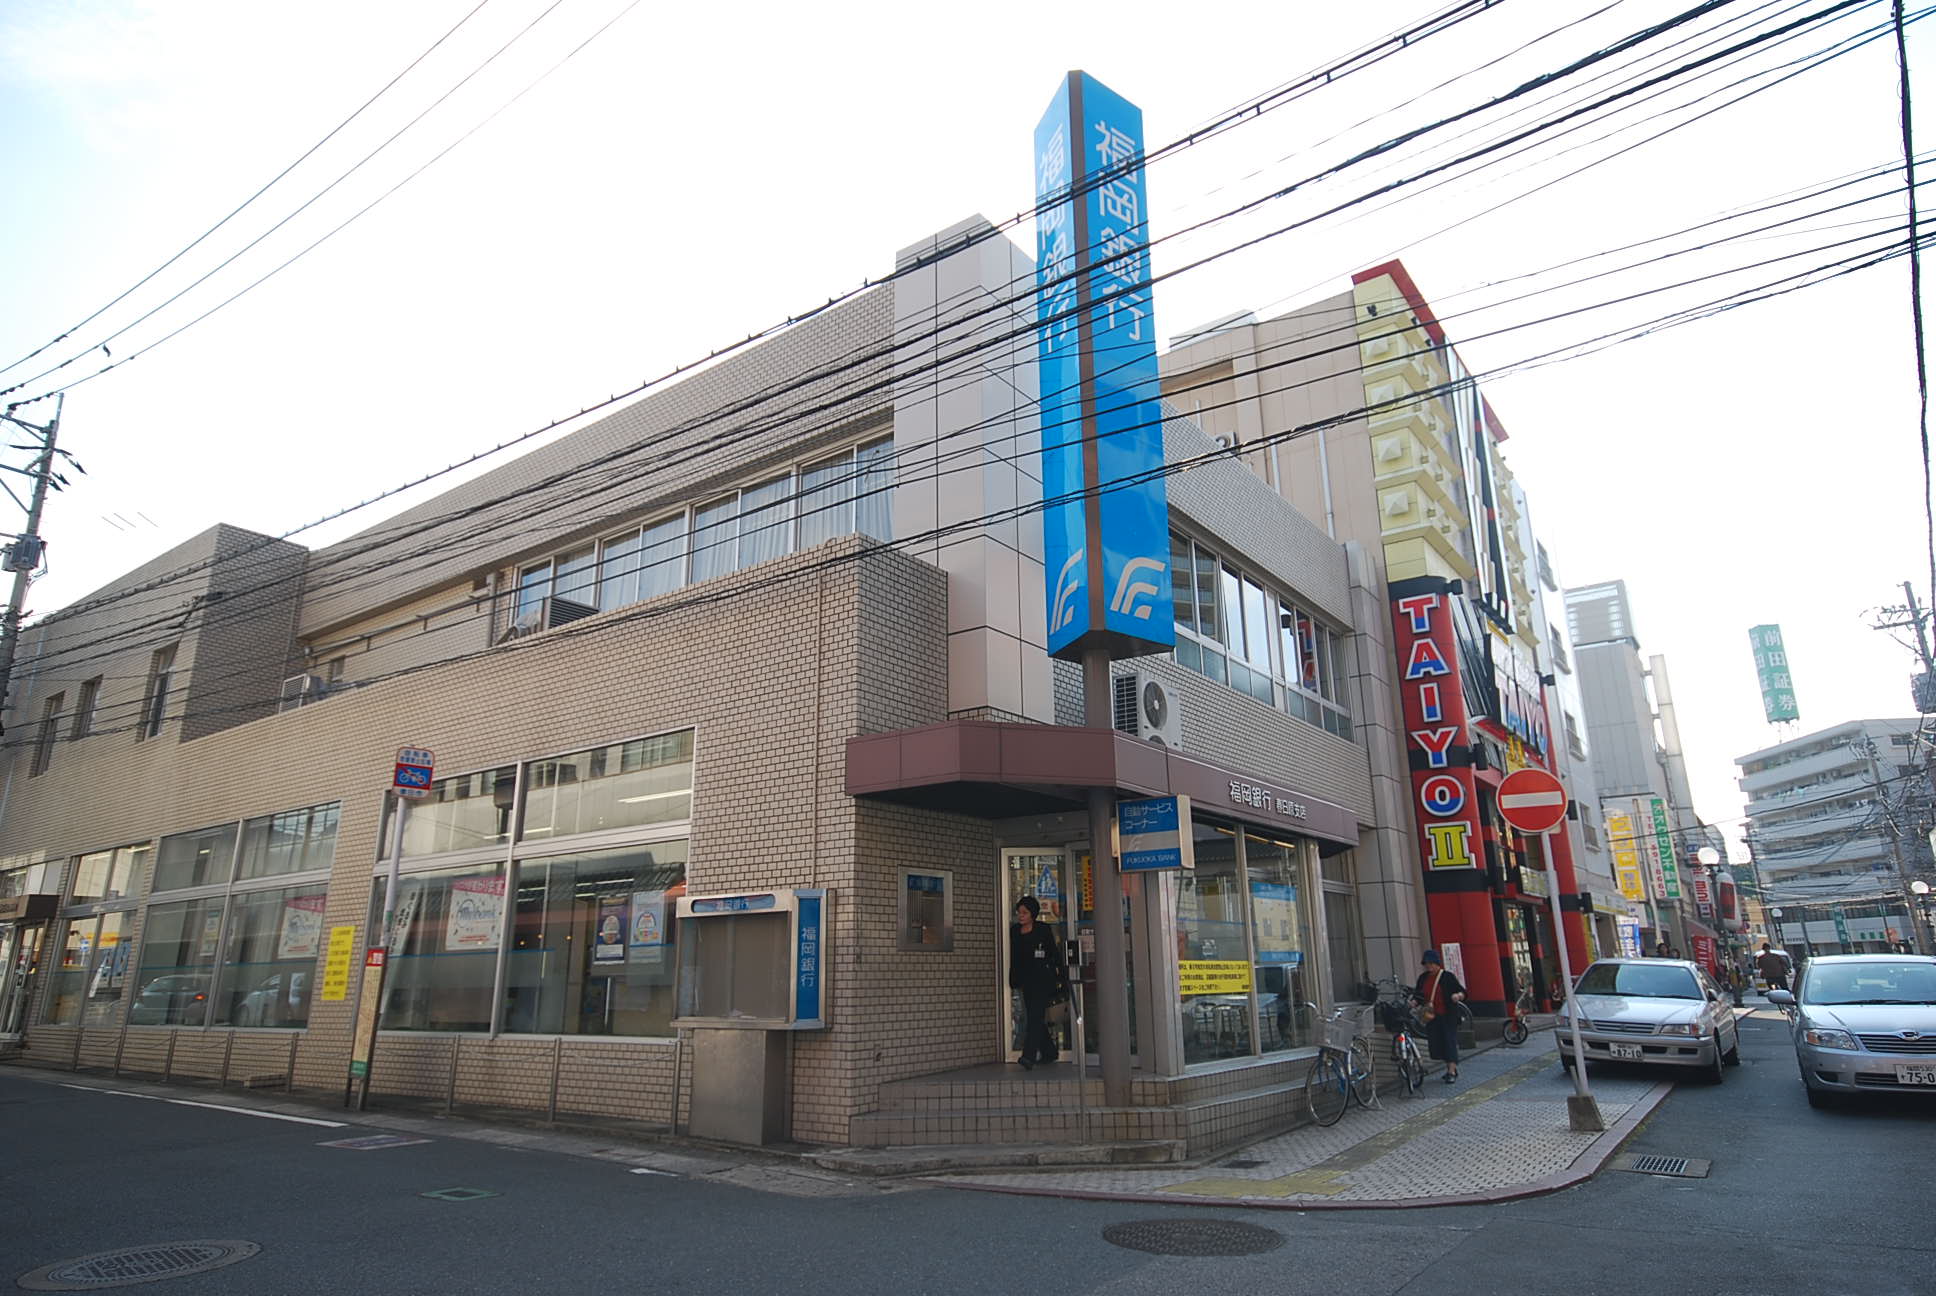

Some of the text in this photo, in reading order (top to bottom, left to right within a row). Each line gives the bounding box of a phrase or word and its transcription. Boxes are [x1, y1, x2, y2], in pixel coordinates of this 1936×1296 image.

[1040, 123, 1071, 353] 福岡銀行
[1095, 120, 1145, 341] 福岡銀行
[1399, 593, 1466, 816] TAIYO
[1764, 629, 1795, 711] 前田証券
[1124, 802, 1173, 817] 自動サービス
[1125, 818, 1158, 829] コーナー
[1229, 780, 1271, 811] 福岡銀行
[801, 927, 817, 988] 福岡銀行
